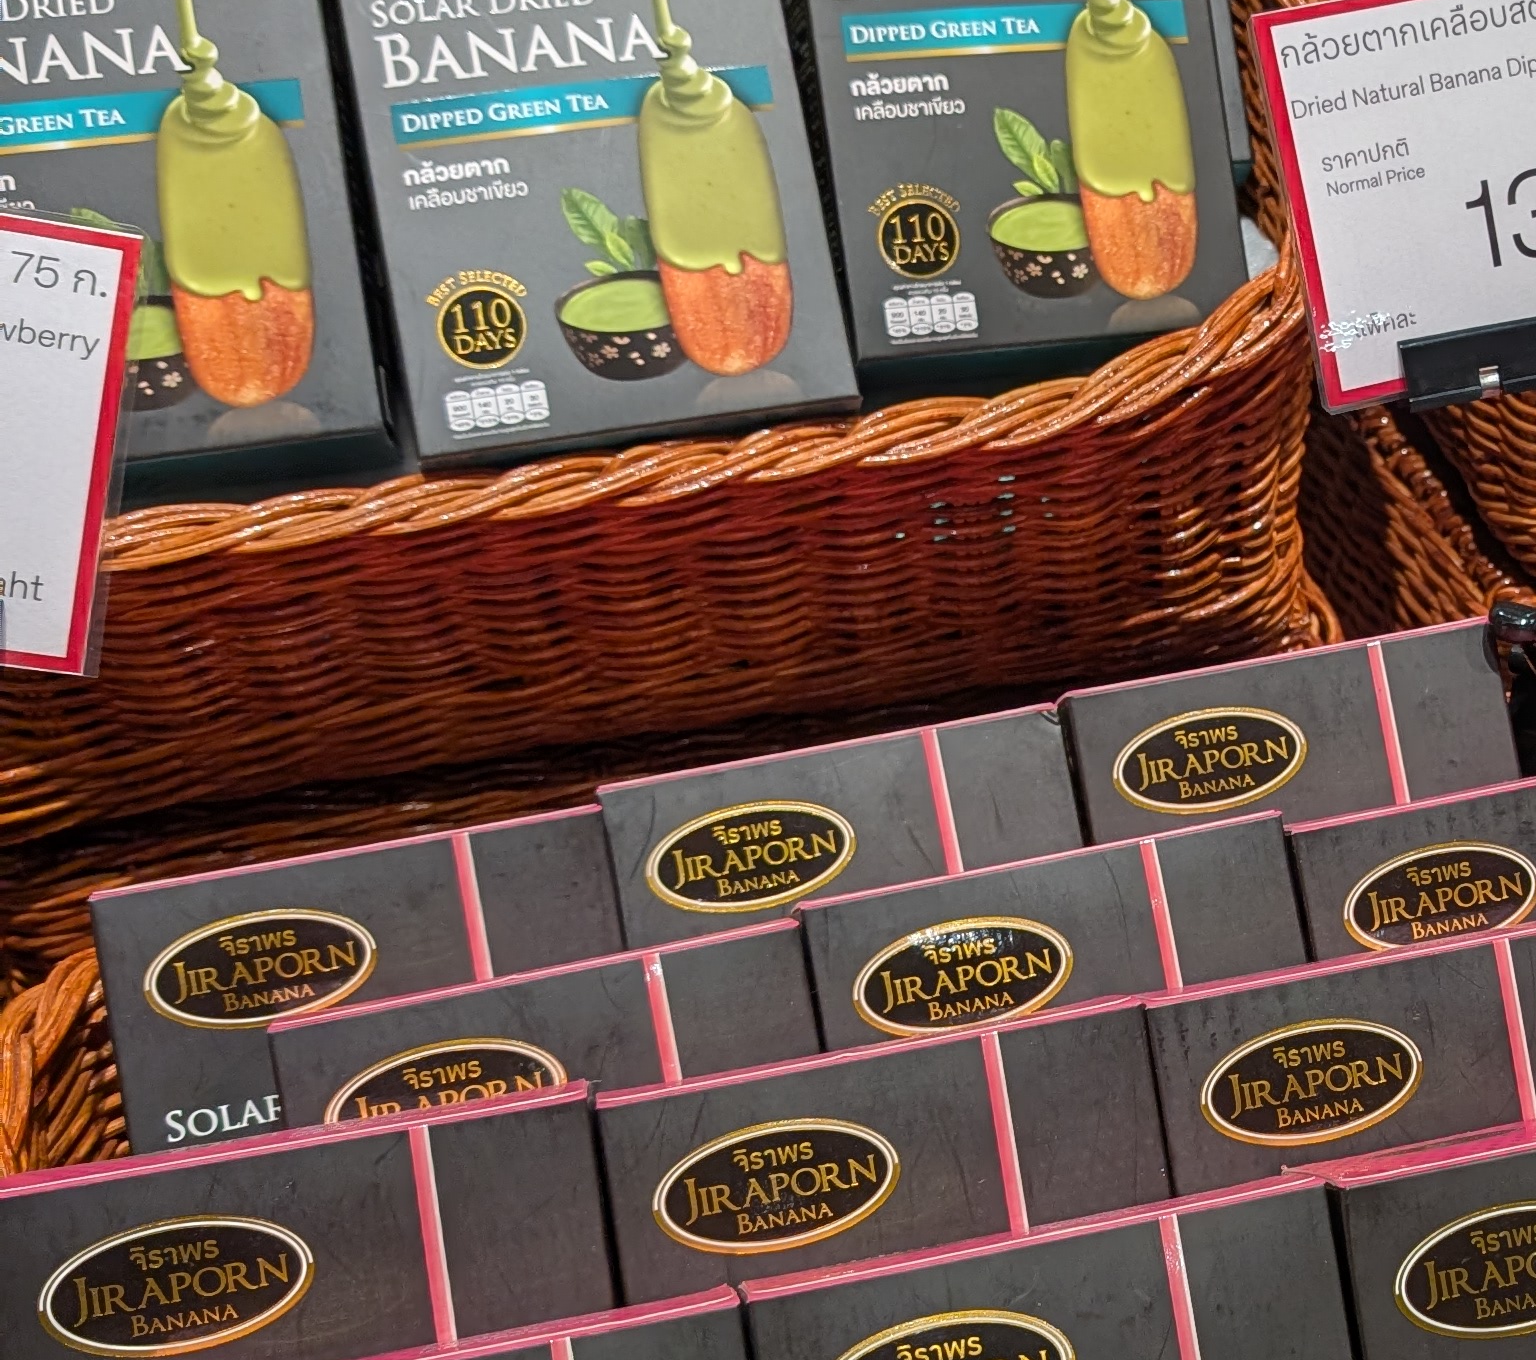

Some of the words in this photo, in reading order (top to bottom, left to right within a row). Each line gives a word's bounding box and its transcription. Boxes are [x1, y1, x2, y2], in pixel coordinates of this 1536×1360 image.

[1290, 89, 1348, 122] Dried
[1352, 73, 1425, 108] Natural
[1429, 62, 1502, 95] Banana
[1321, 137, 1411, 173] ราคาปกติ
[1326, 171, 1384, 197] Normal
[1386, 162, 1426, 187] Price
[887, 210, 946, 245] 110
[11, 250, 60, 289] 75
[73, 269, 107, 298] ก.
[446, 295, 512, 336] 110
